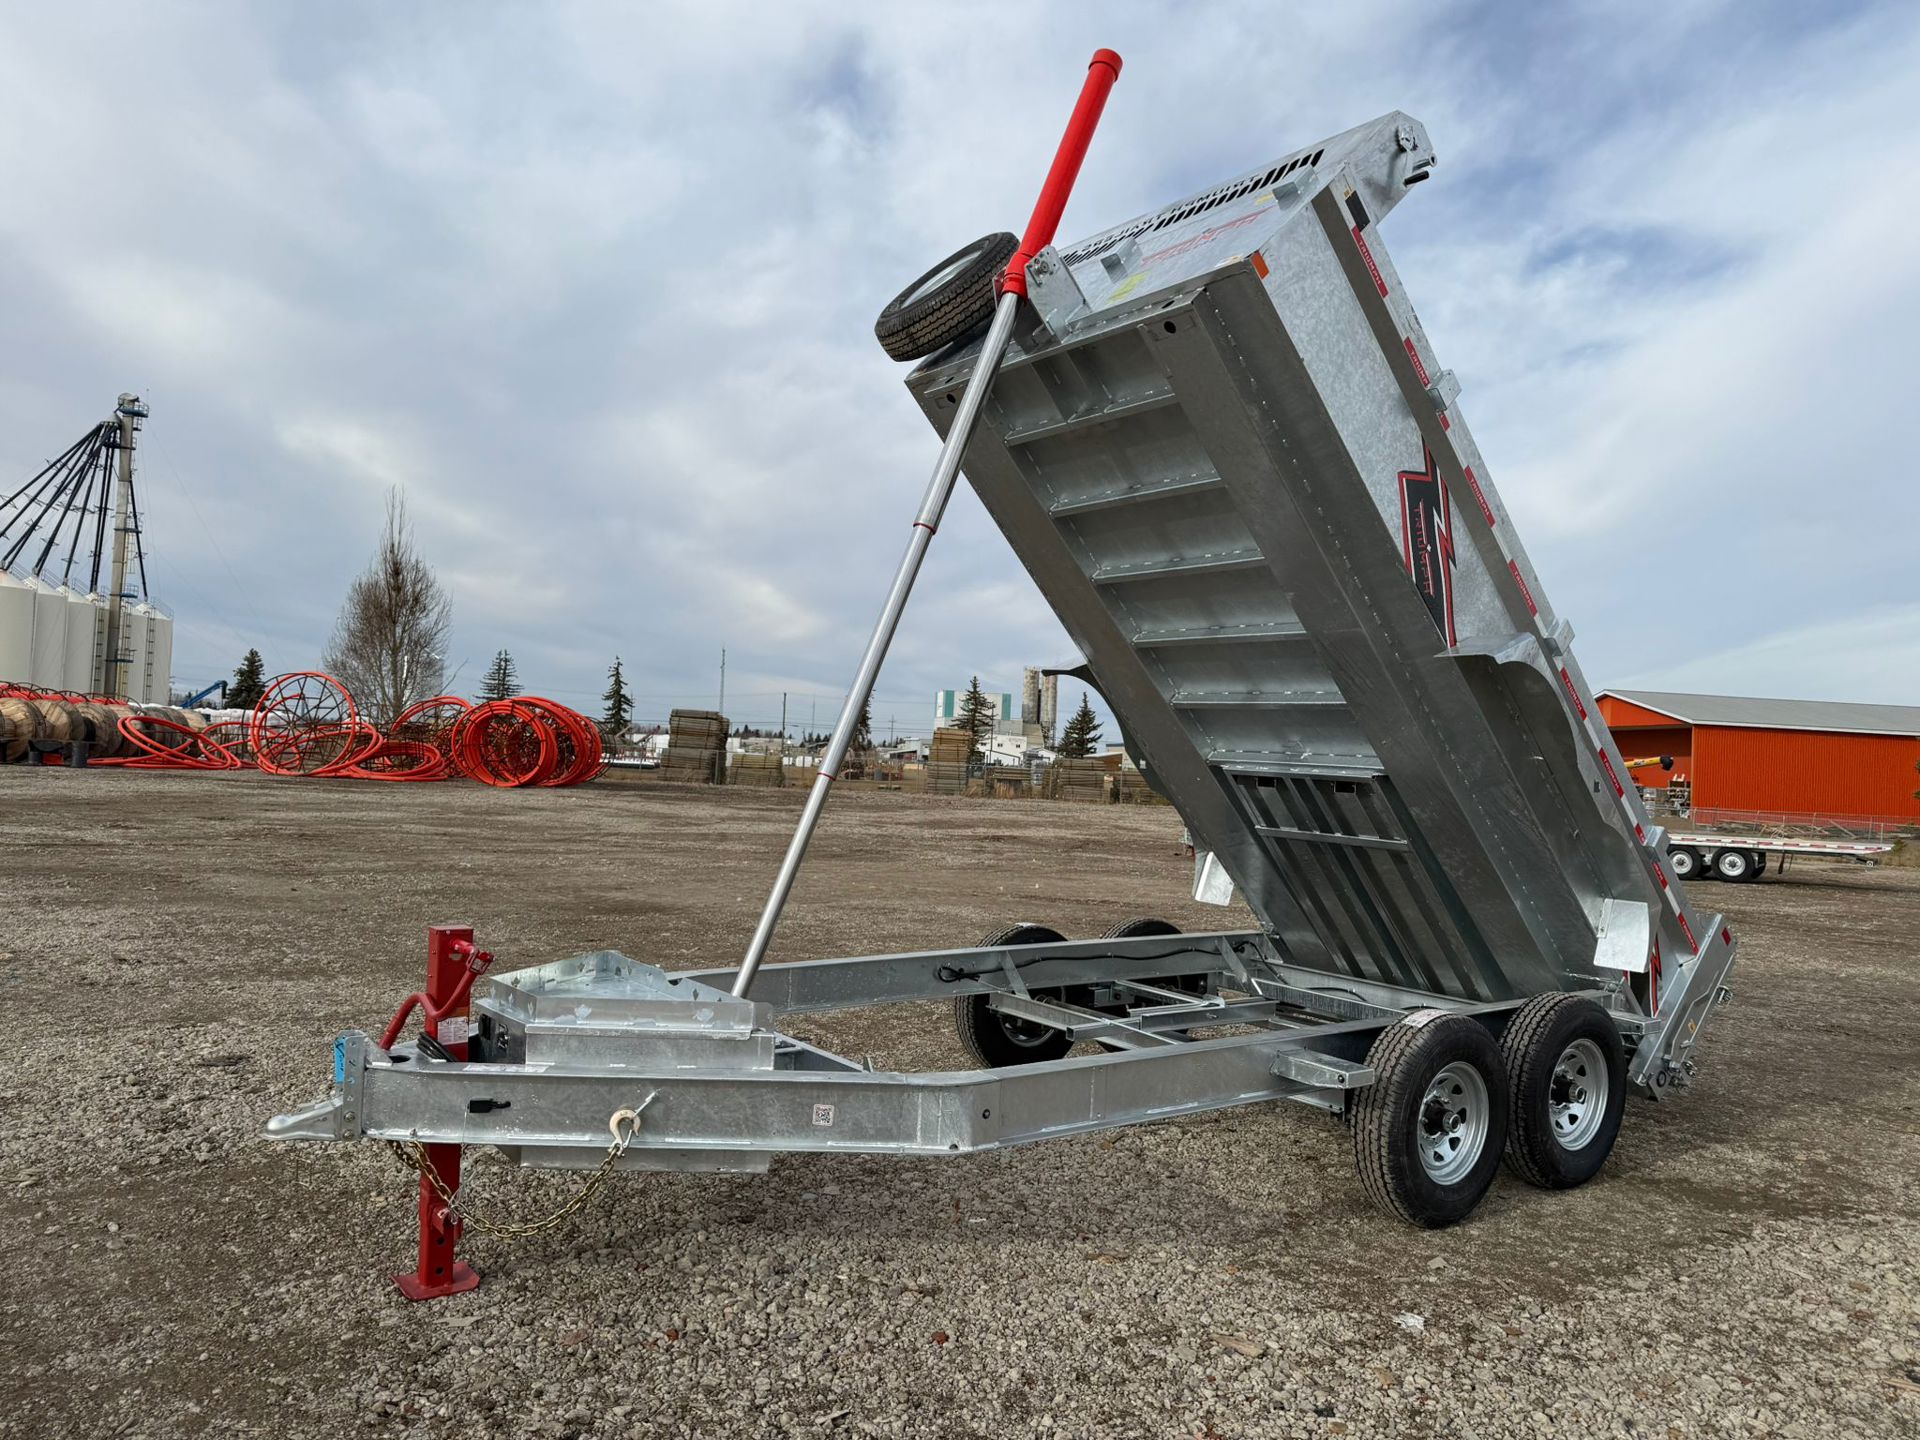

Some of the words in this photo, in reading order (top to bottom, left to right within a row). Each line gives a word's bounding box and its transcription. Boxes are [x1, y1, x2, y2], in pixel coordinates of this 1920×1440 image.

[1358, 240, 1382, 284] TRIUMPH
[1409, 351, 1430, 385] TRIUMP
[1470, 478, 1491, 516] TRIUMPH
[1413, 507, 1432, 595] TRIUMPH
[1514, 571, 1534, 606] TRIUMPH
